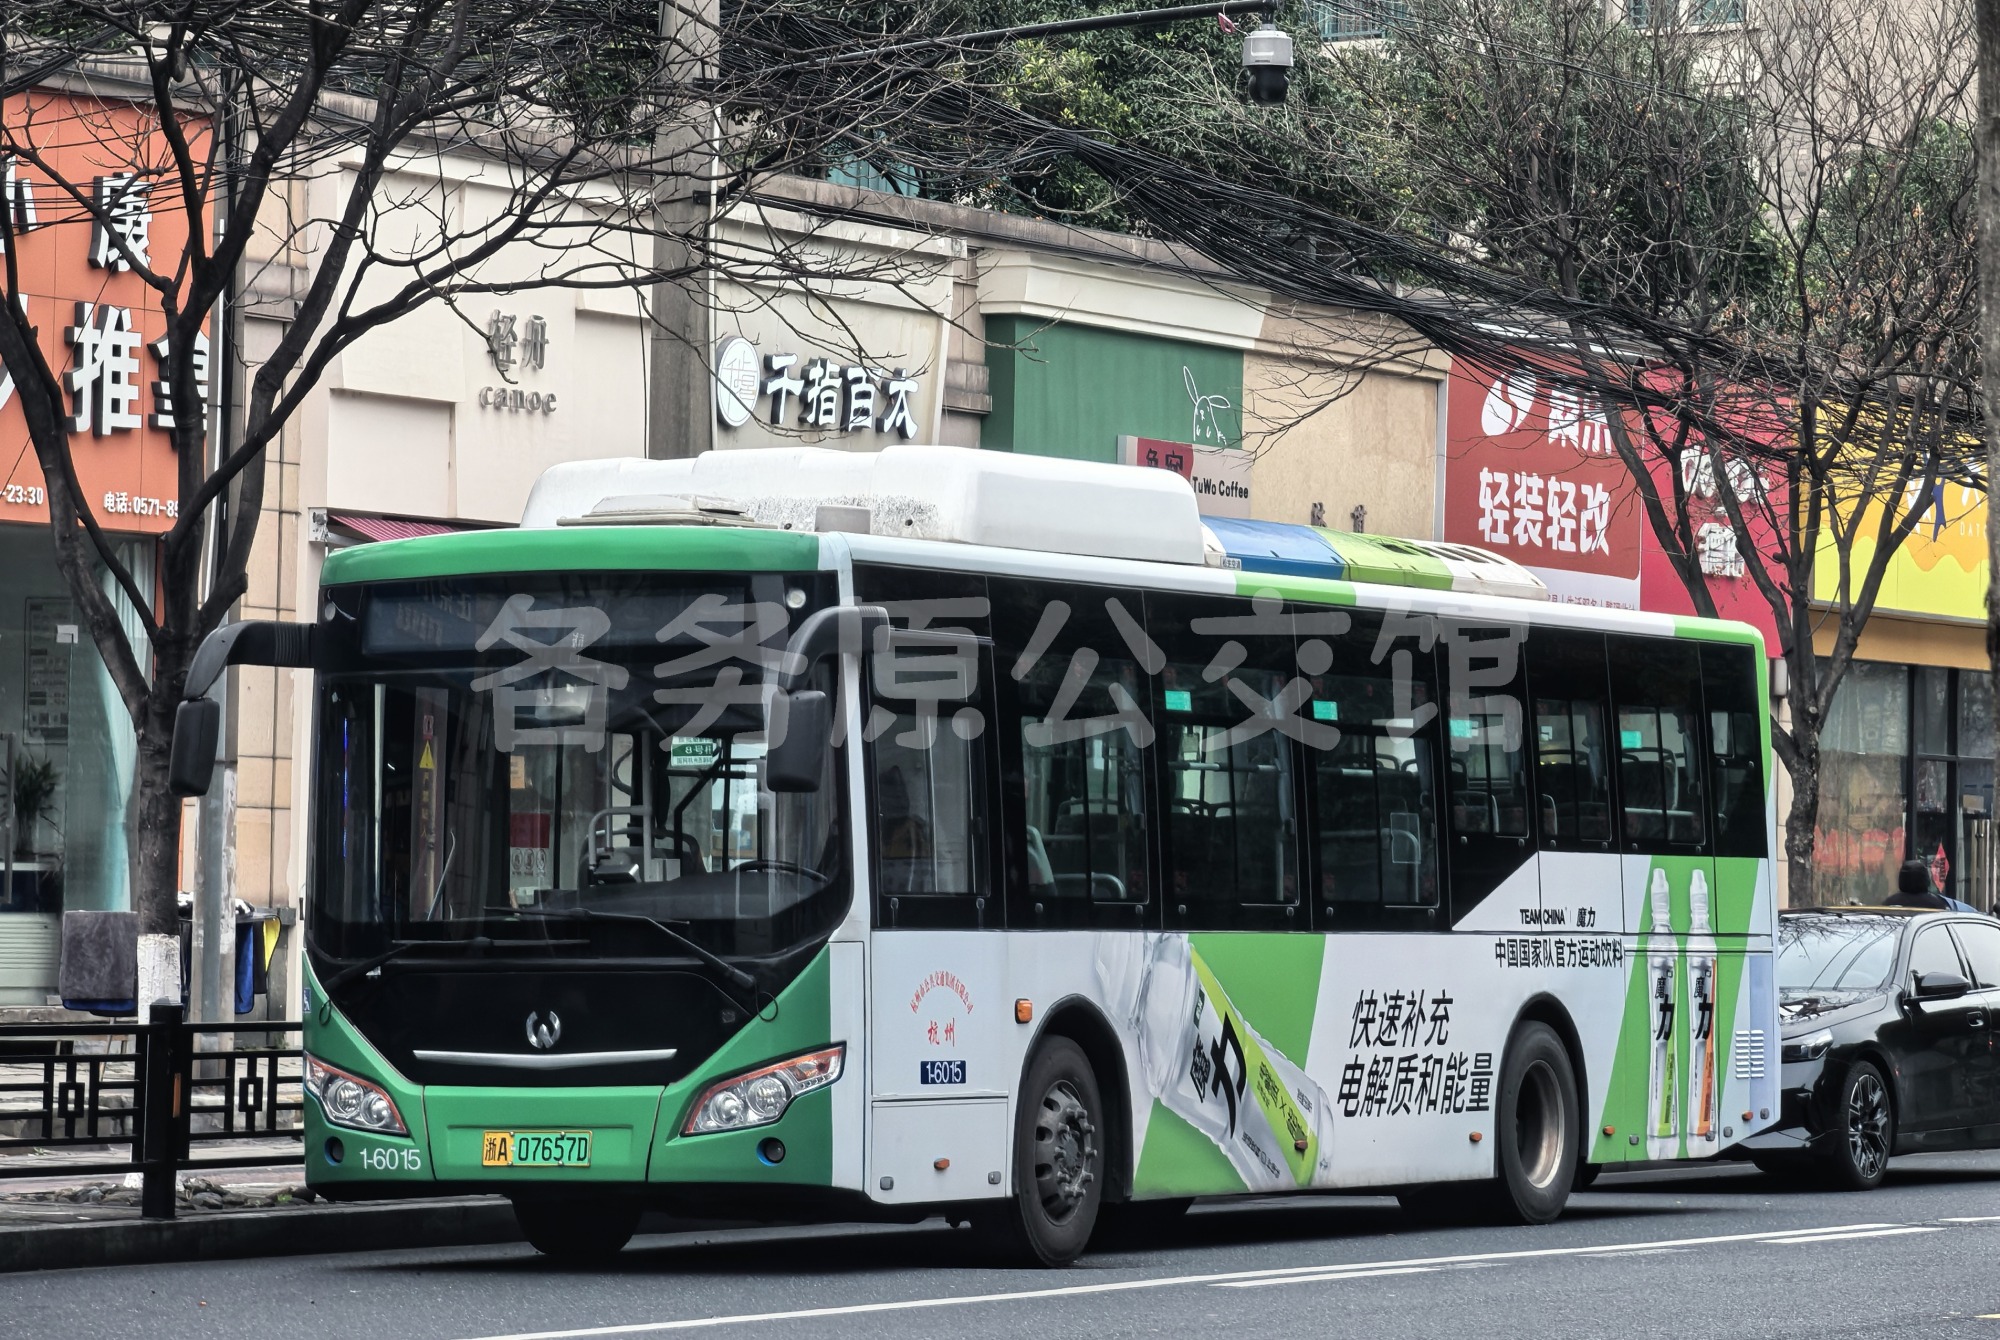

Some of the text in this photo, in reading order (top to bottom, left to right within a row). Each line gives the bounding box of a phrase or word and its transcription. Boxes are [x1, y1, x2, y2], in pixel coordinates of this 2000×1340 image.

[480, 386, 557, 413] canoe
[1193, 476, 1249, 499] TuWo Coffee
[1478, 466, 1611, 558] 轻装轻改
[1520, 909, 1566, 925] TEAM CHINA
[1576, 906, 1596, 928] 魔力
[1495, 937, 1623, 968] 中国国家队官方运动饮料
[927, 1017, 955, 1047] 杭州
[1349, 989, 1453, 1049] 快速补充
[926, 1061, 962, 1083] 1-6015
[1338, 1052, 1494, 1118] 电解质和能量
[359, 1148, 421, 1171] 1-6015
[485, 1137, 588, 1163] 浙A 07657D
